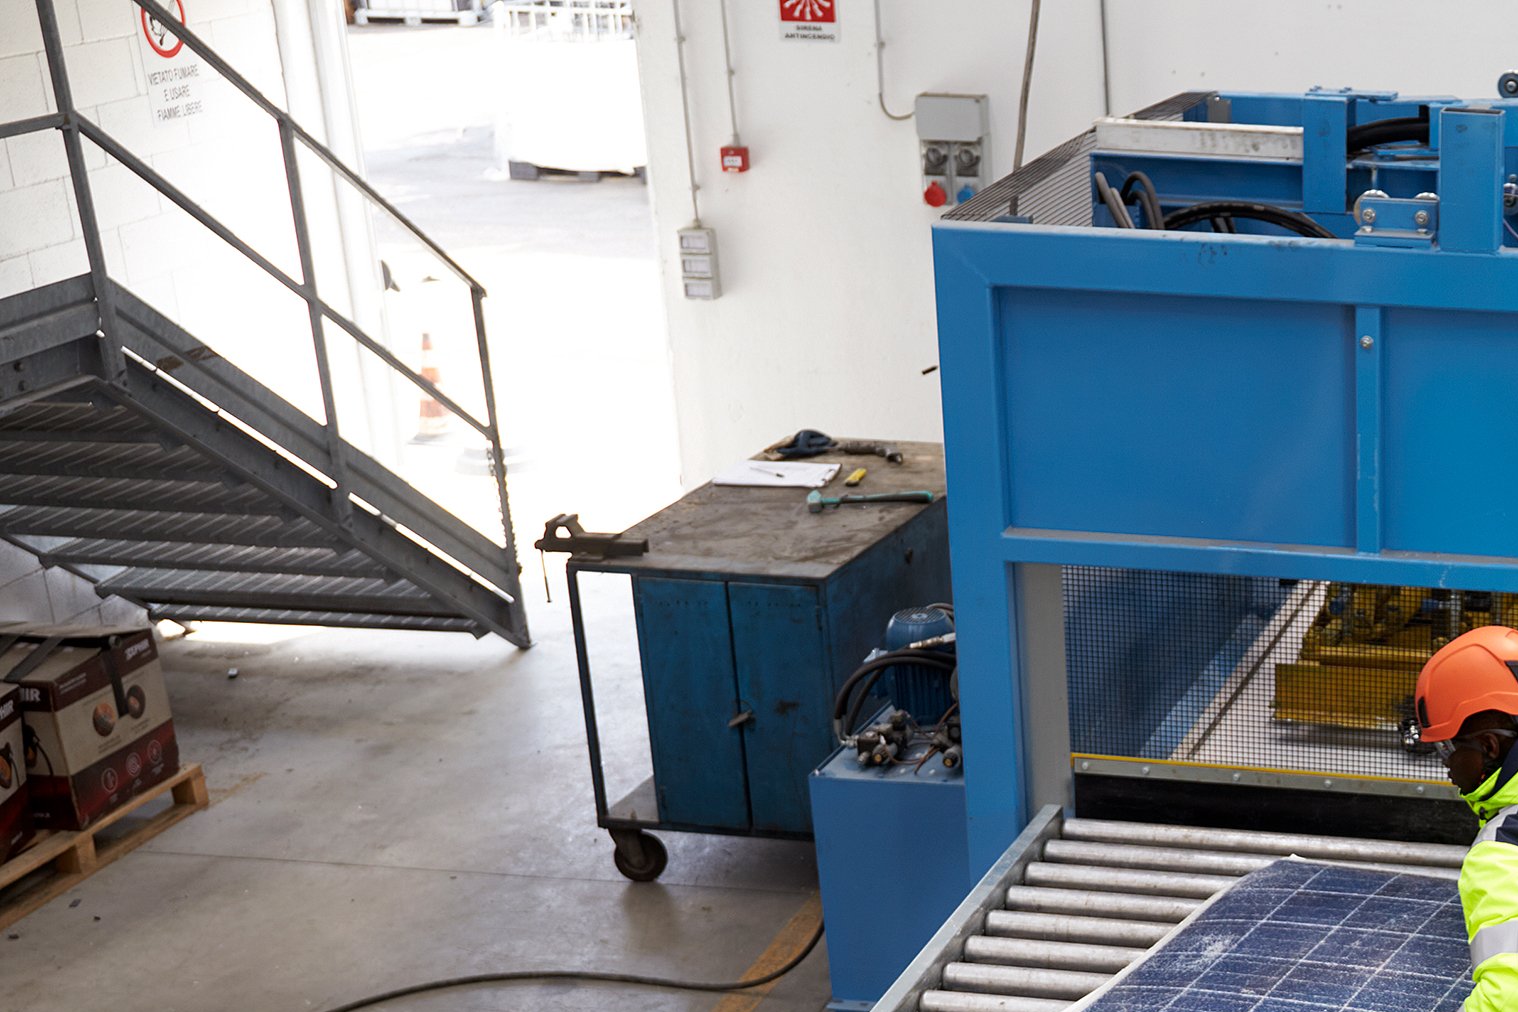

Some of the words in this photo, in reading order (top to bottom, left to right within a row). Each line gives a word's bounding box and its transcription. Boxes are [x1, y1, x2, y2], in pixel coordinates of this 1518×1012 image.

[148, 69, 174, 85] VIETATO
[173, 64, 199, 80] FUMARE
[163, 89, 169, 102] E
[156, 105, 182, 121] FIAMME
